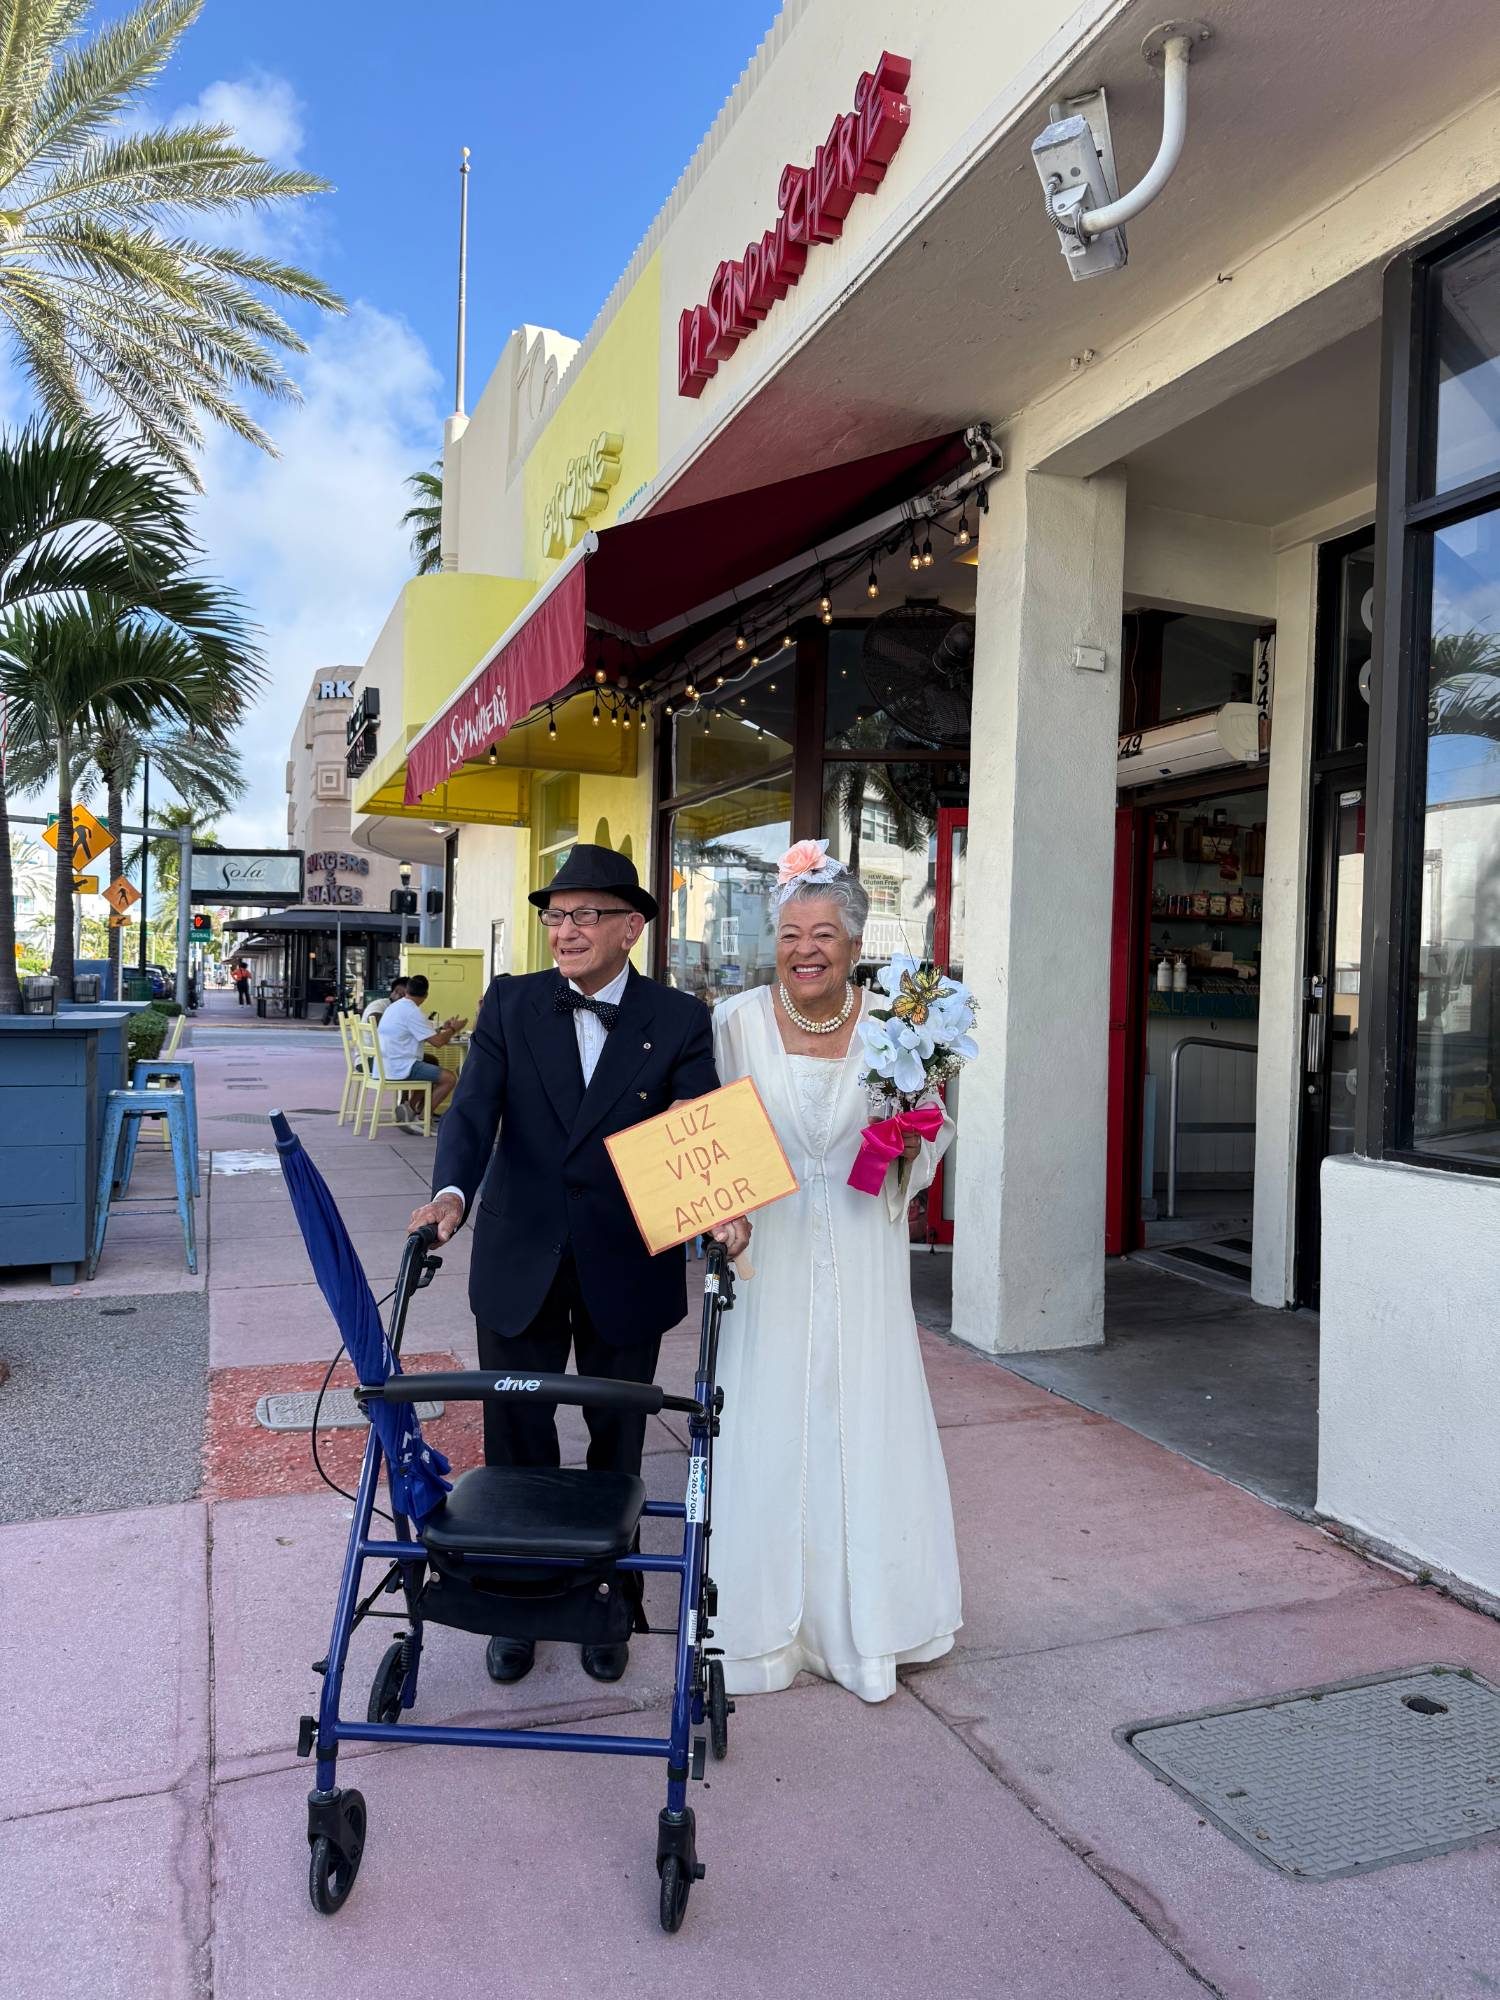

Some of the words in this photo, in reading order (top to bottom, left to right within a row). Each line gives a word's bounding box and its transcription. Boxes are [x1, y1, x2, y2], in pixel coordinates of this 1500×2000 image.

[319, 680, 355, 699] RK
[217, 859, 274, 890] Sola
[307, 885, 363, 905] SHAKES
[864, 923, 903, 942] IRING
[665, 1103, 717, 1146] LUZ
[665, 1139, 730, 1181] VIDA
[675, 1177, 756, 1233] AMOR
[494, 1376, 541, 1392] drive
[689, 1458, 700, 1521] 305-262-7004
